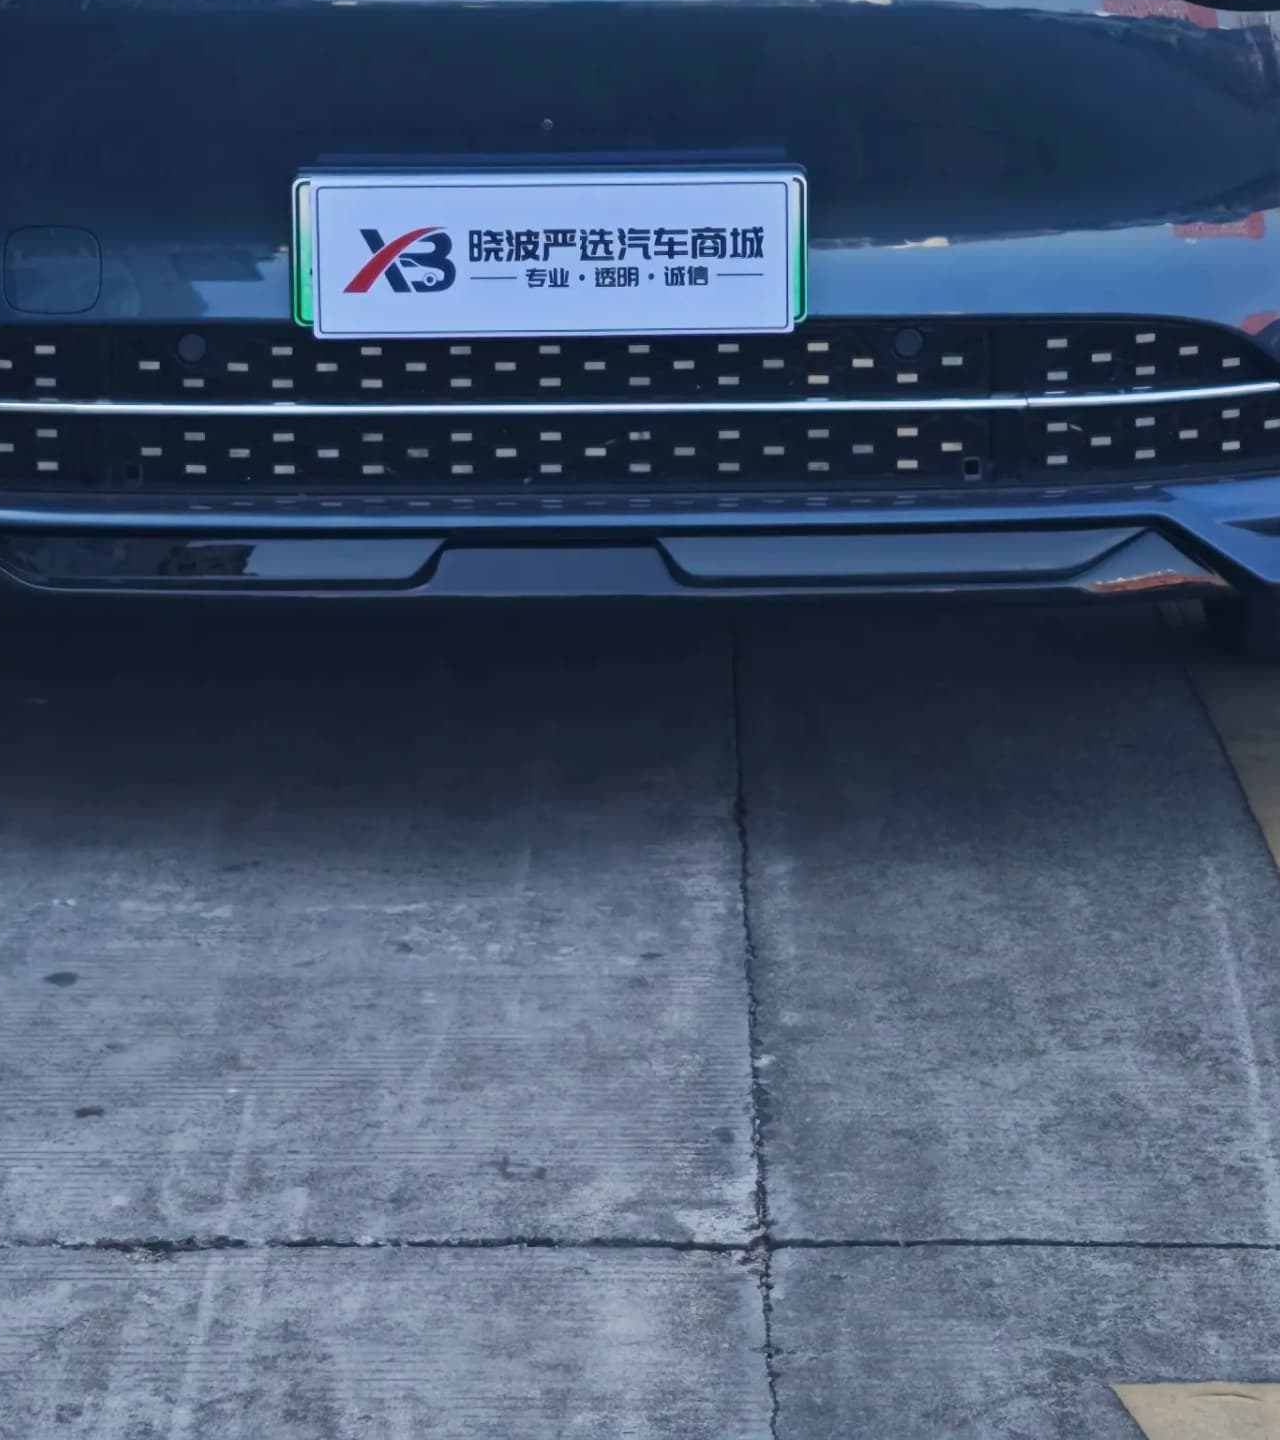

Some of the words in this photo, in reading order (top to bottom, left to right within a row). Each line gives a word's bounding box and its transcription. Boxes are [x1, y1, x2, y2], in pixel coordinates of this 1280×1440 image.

[468, 226, 765, 263] 晓波严选汽车商城
